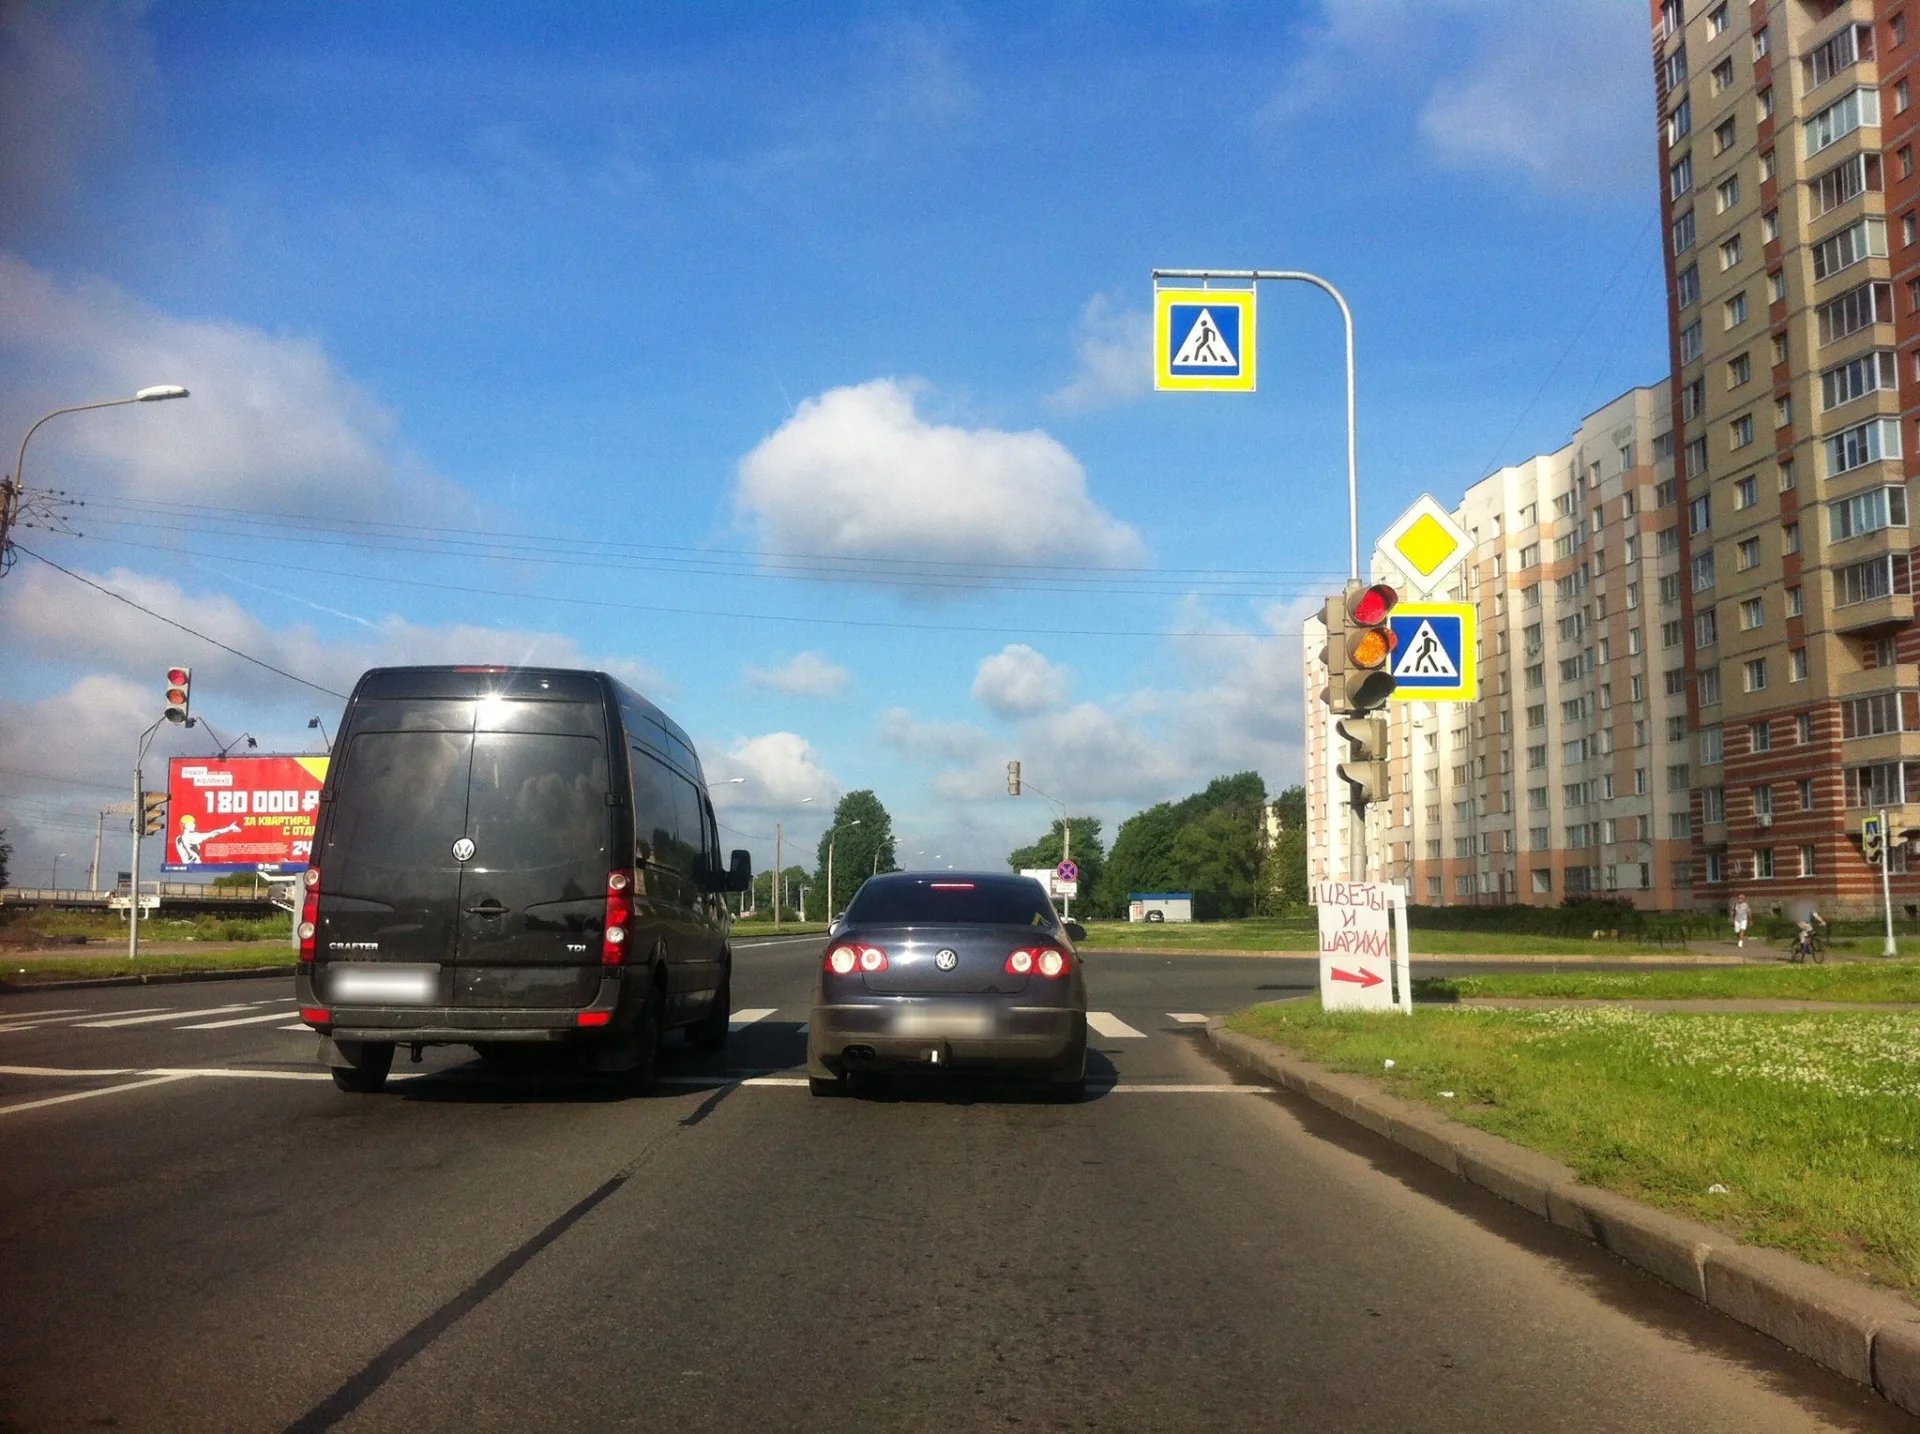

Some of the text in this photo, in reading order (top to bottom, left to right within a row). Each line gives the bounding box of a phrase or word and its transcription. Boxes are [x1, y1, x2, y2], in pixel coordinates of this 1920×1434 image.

[204, 791, 248, 813] 180
[252, 790, 299, 813] 000
[243, 816, 310, 826] ЗА КВАРТИРУ
[283, 826, 290, 836] С
[1320, 882, 1385, 911] ЦВЕТЫ
[1341, 908, 1356, 928] И
[329, 942, 379, 950] CRAFTER
[566, 944, 587, 952] TDI
[1321, 929, 1389, 958] ШАРИКИ
